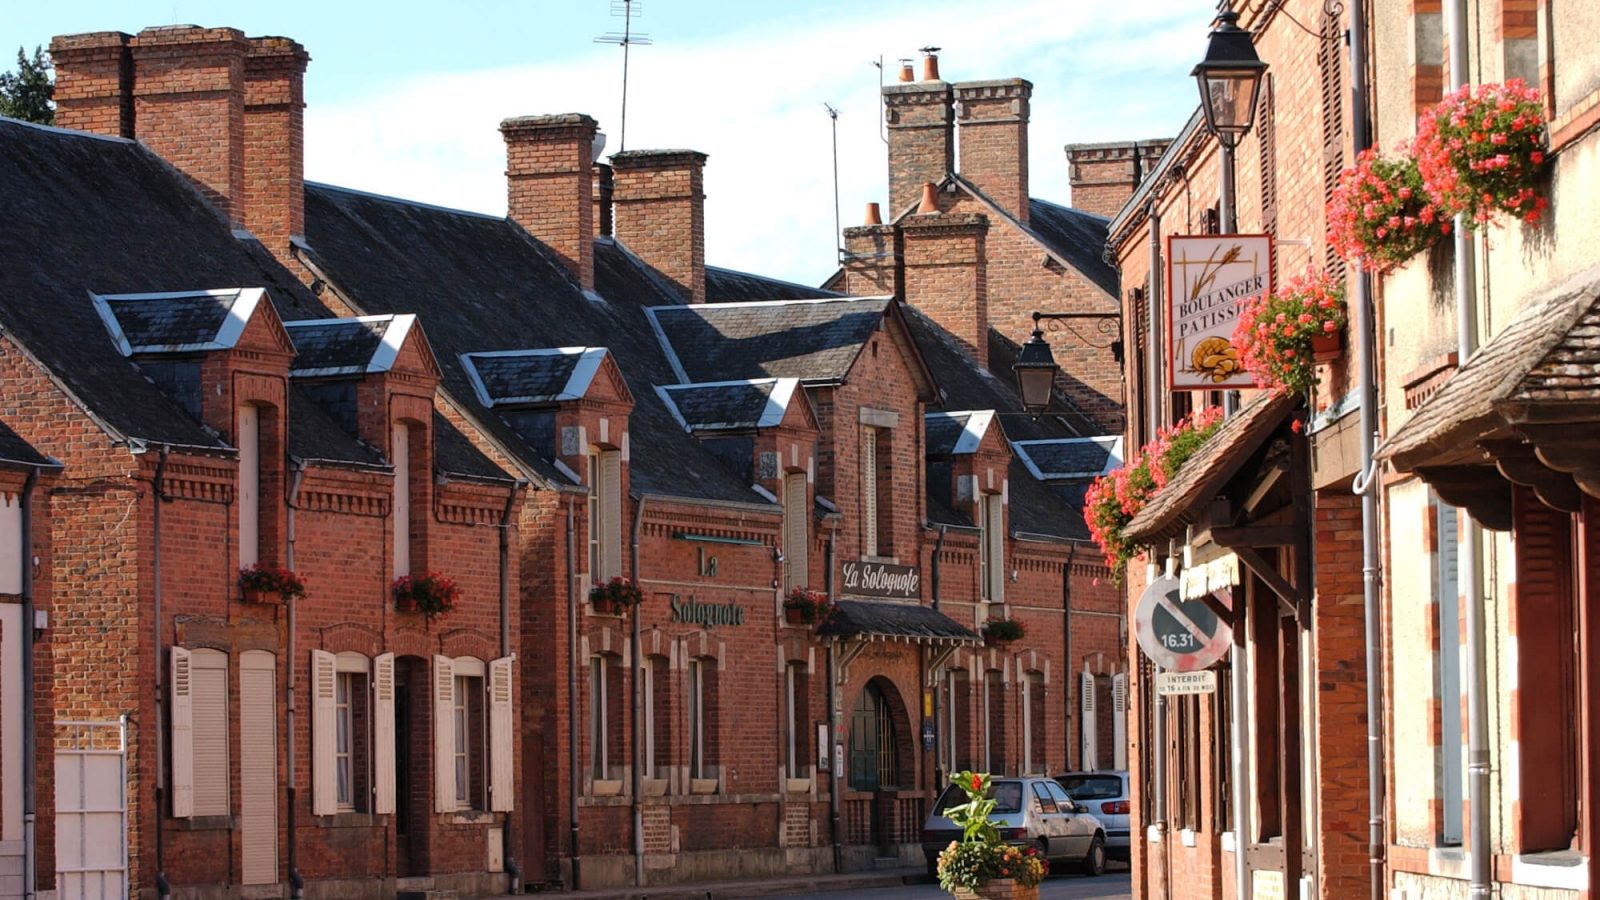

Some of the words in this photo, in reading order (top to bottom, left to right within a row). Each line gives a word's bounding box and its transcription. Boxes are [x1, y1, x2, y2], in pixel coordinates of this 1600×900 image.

[1180, 276, 1262, 318] BOULANGER
[1180, 296, 1262, 337] PATISSI
[697, 547, 718, 576] La
[843, 562, 859, 588] La
[862, 564, 919, 596] Solognote
[671, 593, 745, 630] Solognote
[1167, 674, 1206, 683] INTERDIT
